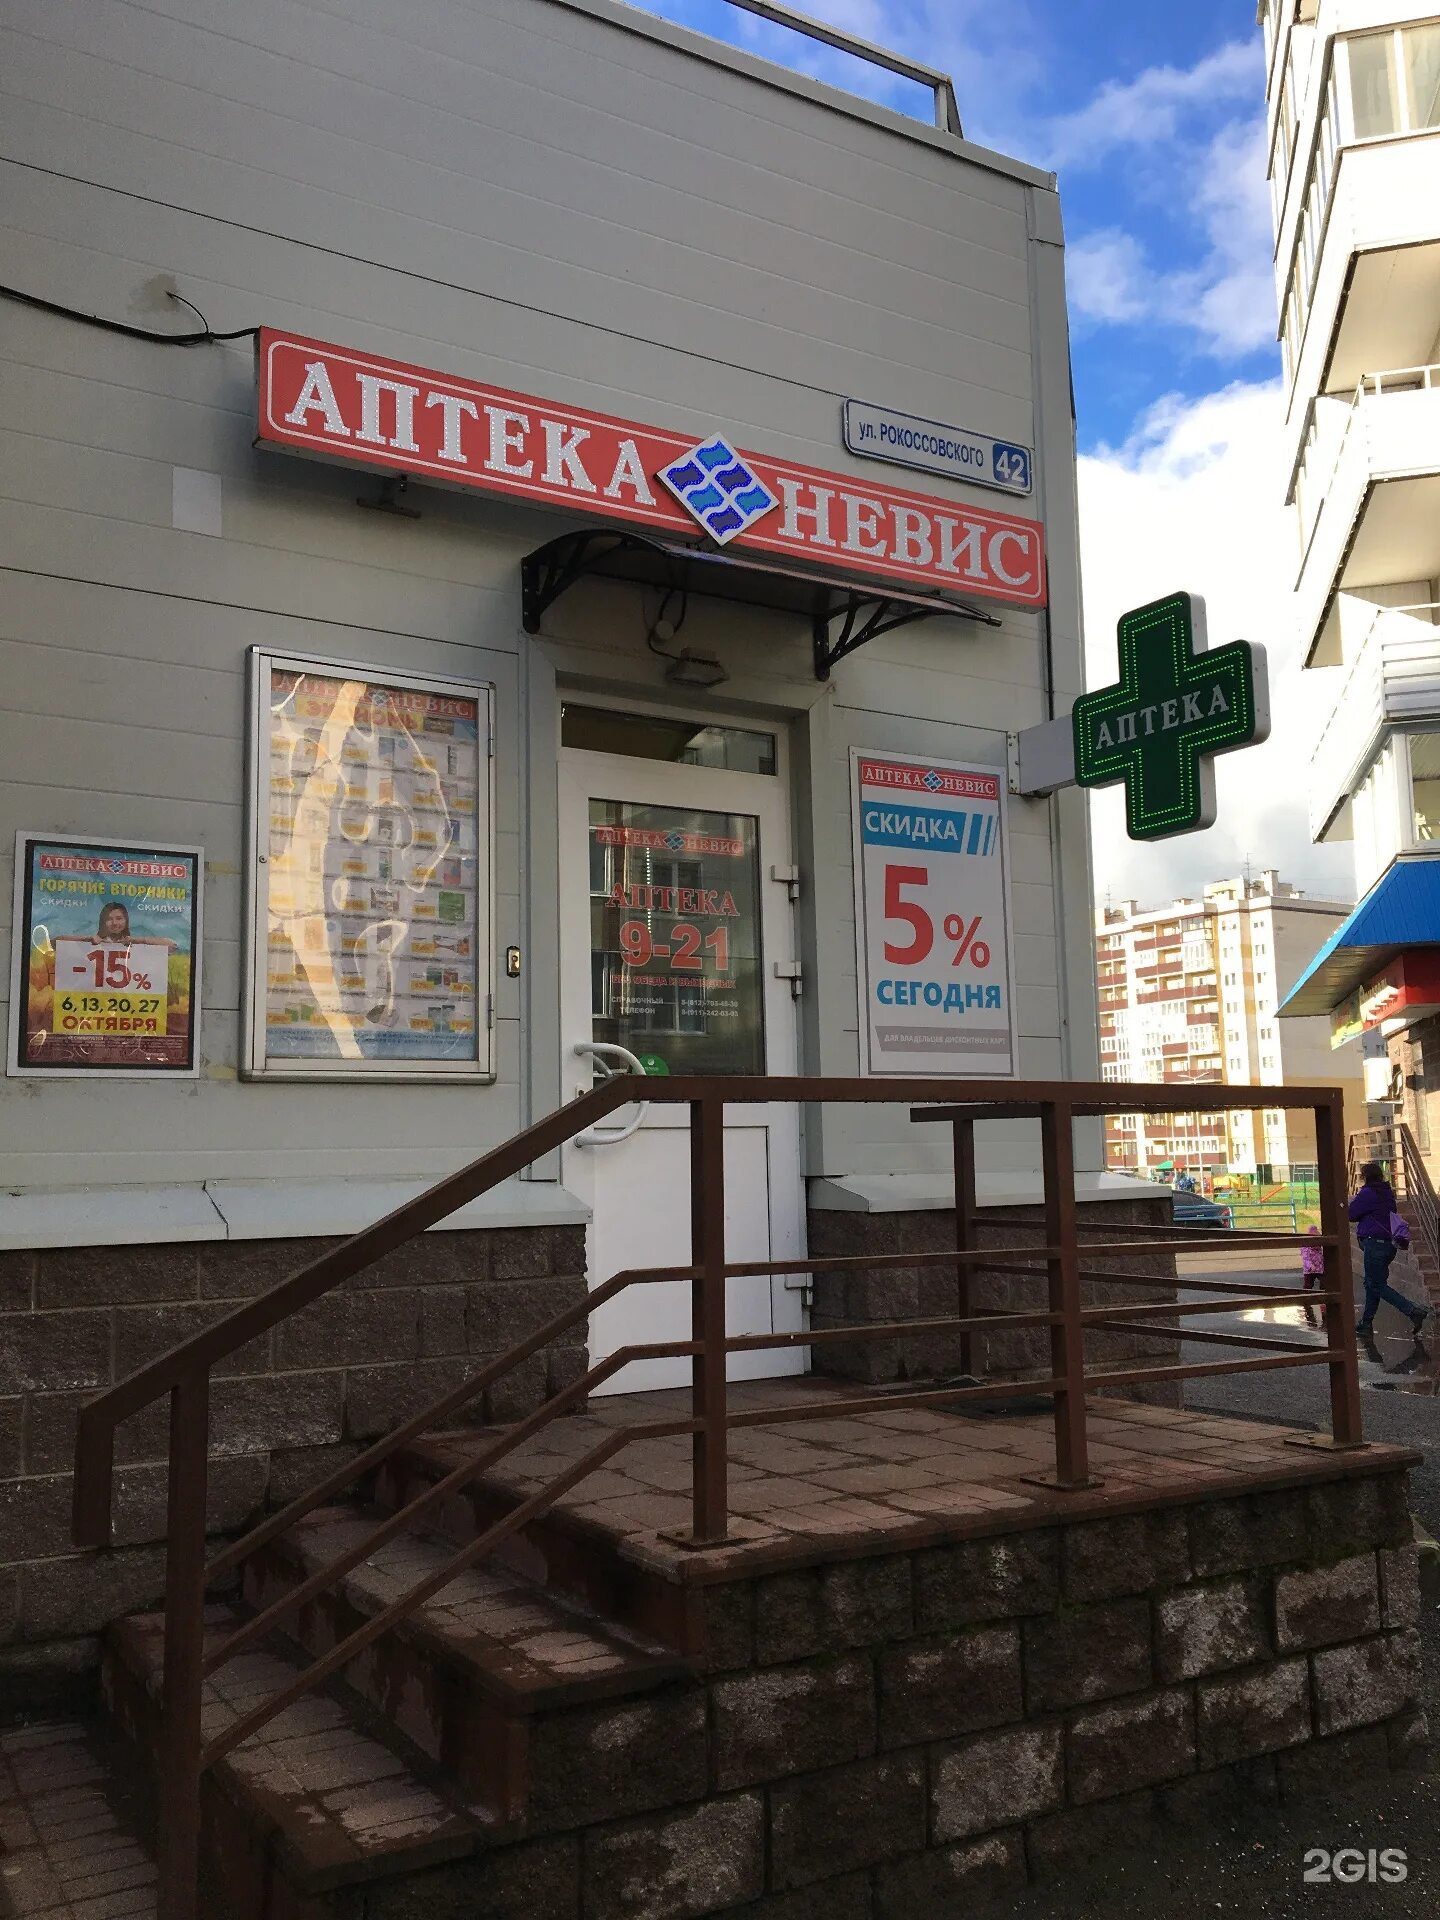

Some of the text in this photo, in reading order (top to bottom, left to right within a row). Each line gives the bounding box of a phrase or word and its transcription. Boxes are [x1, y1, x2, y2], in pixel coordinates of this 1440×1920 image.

[858, 421, 1026, 483] ул. РОКОССОВСКОГО 42
[284, 361, 1032, 585] АПТЕКА НЕВИС
[1095, 684, 1230, 751] АПТЕКА
[864, 767, 994, 795] АПТЕКА НЕВИС
[600, 832, 740, 853] АПТЕКА НЕВИС
[864, 811, 959, 843] СКИДКА
[43, 858, 183, 877] АПТЕКА НЕВИС
[39, 878, 186, 900] ГОРЯЧИЕ ВТОРНИКИ
[605, 883, 740, 917] АПТЕКА
[619, 921, 729, 971] 9-21
[81, 998, 103, 1013] 13,
[107, 999, 135, 1014] 20,
[139, 1000, 160, 1013] 27
[876, 980, 1002, 1014] СЕГОДНЯ
[62, 1015, 157, 1031] ОКТЯБРЯ
